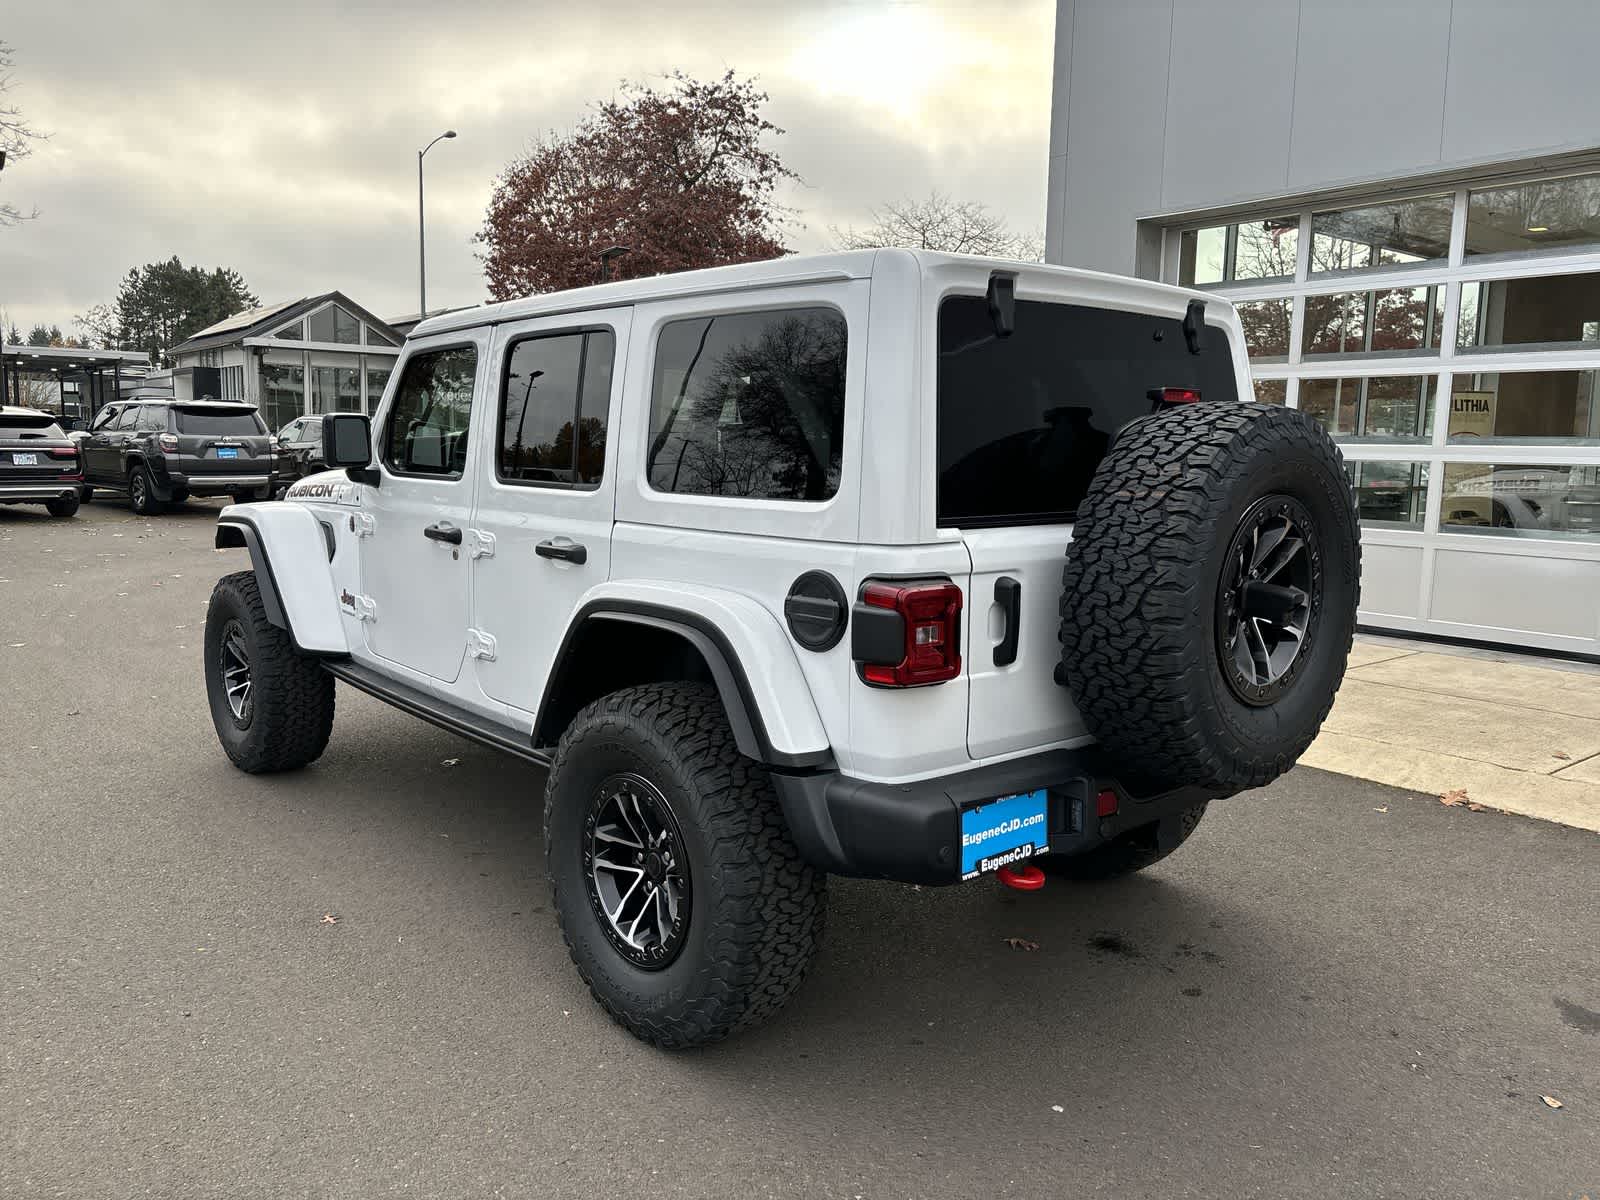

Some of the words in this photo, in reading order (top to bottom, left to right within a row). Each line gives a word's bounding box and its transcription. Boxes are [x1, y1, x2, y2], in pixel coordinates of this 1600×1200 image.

[1454, 399, 1489, 412] LITHIA
[287, 484, 335, 497] RUBICON
[962, 813, 1044, 847] EugeneCJD.com
[981, 844, 1032, 872] EugeneCJD
